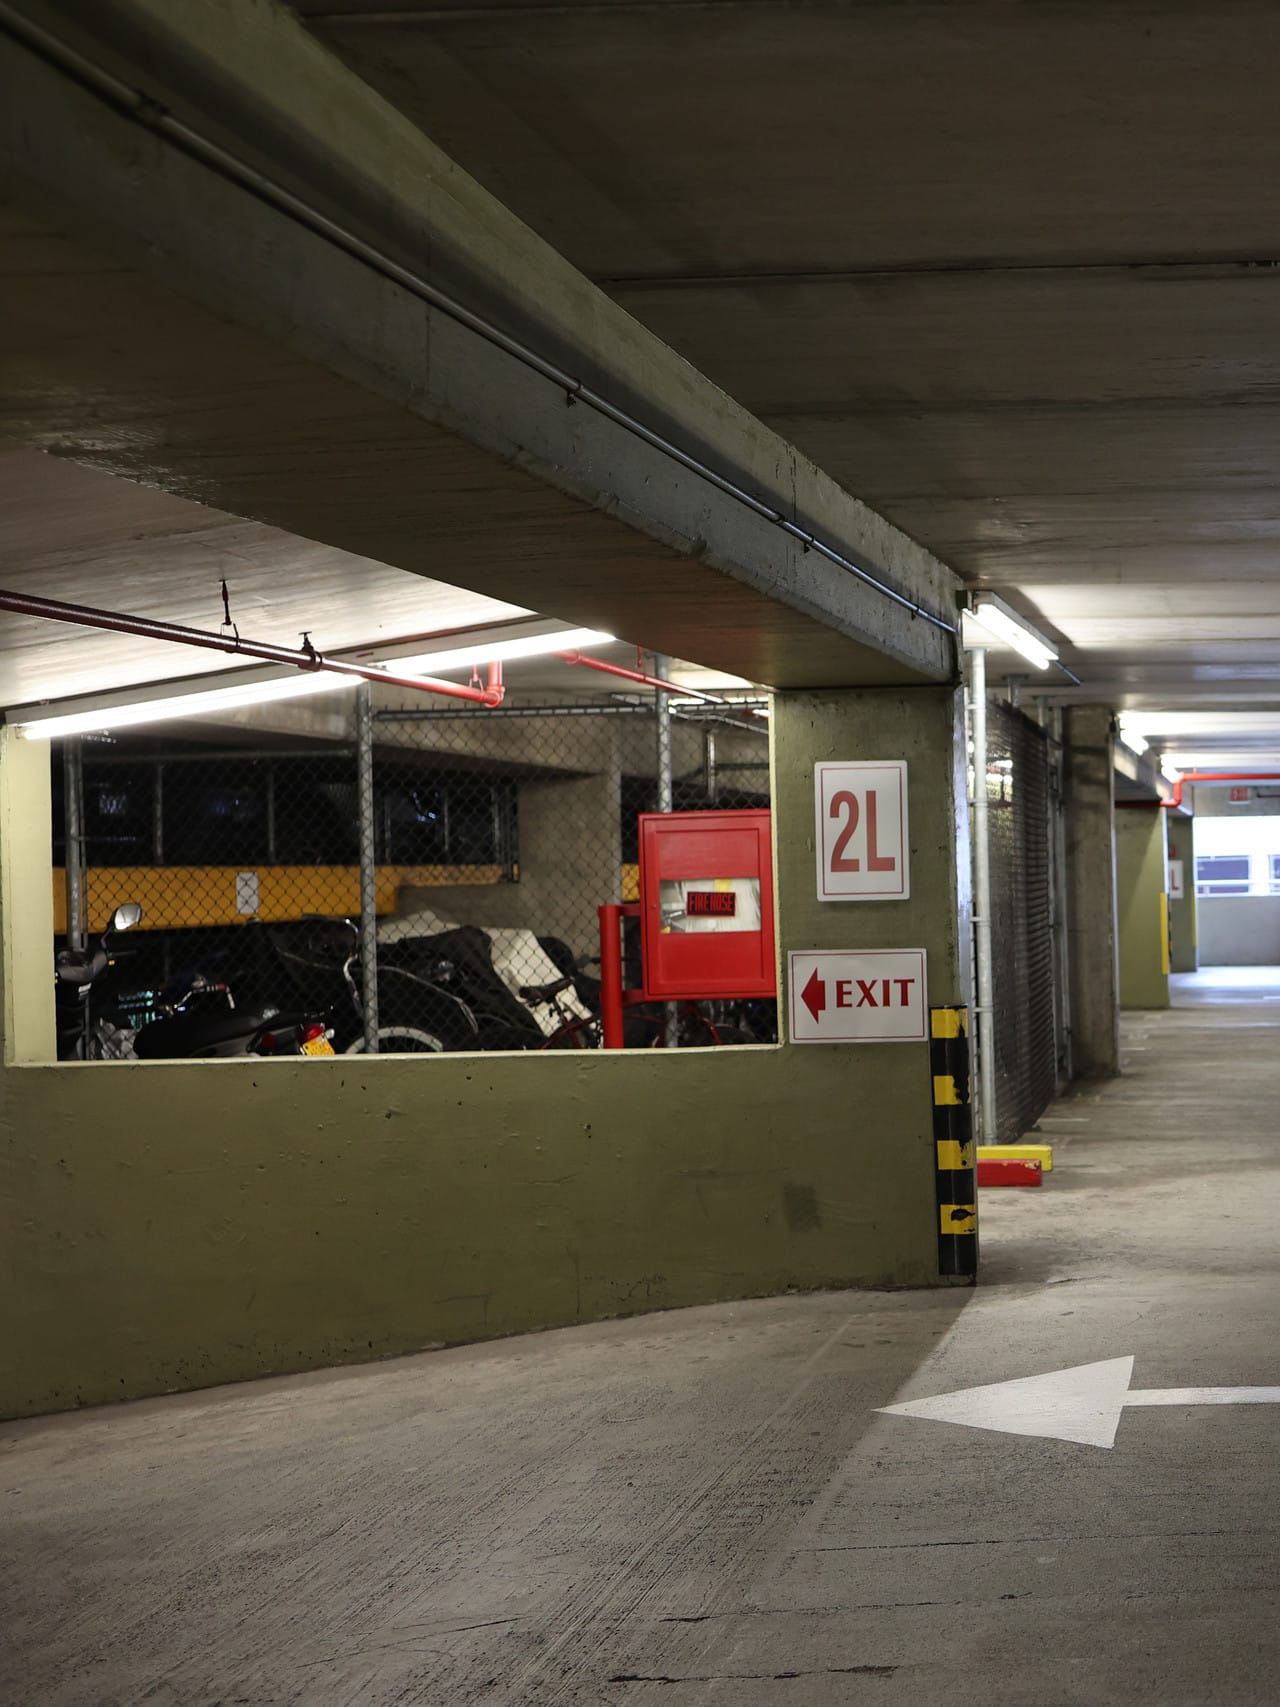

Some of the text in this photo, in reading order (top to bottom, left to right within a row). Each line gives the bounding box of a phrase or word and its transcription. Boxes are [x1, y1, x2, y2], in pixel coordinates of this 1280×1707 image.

[830, 791, 895, 872] 2L
[690, 893, 709, 911] FIRE
[835, 979, 915, 1008] EXIT
